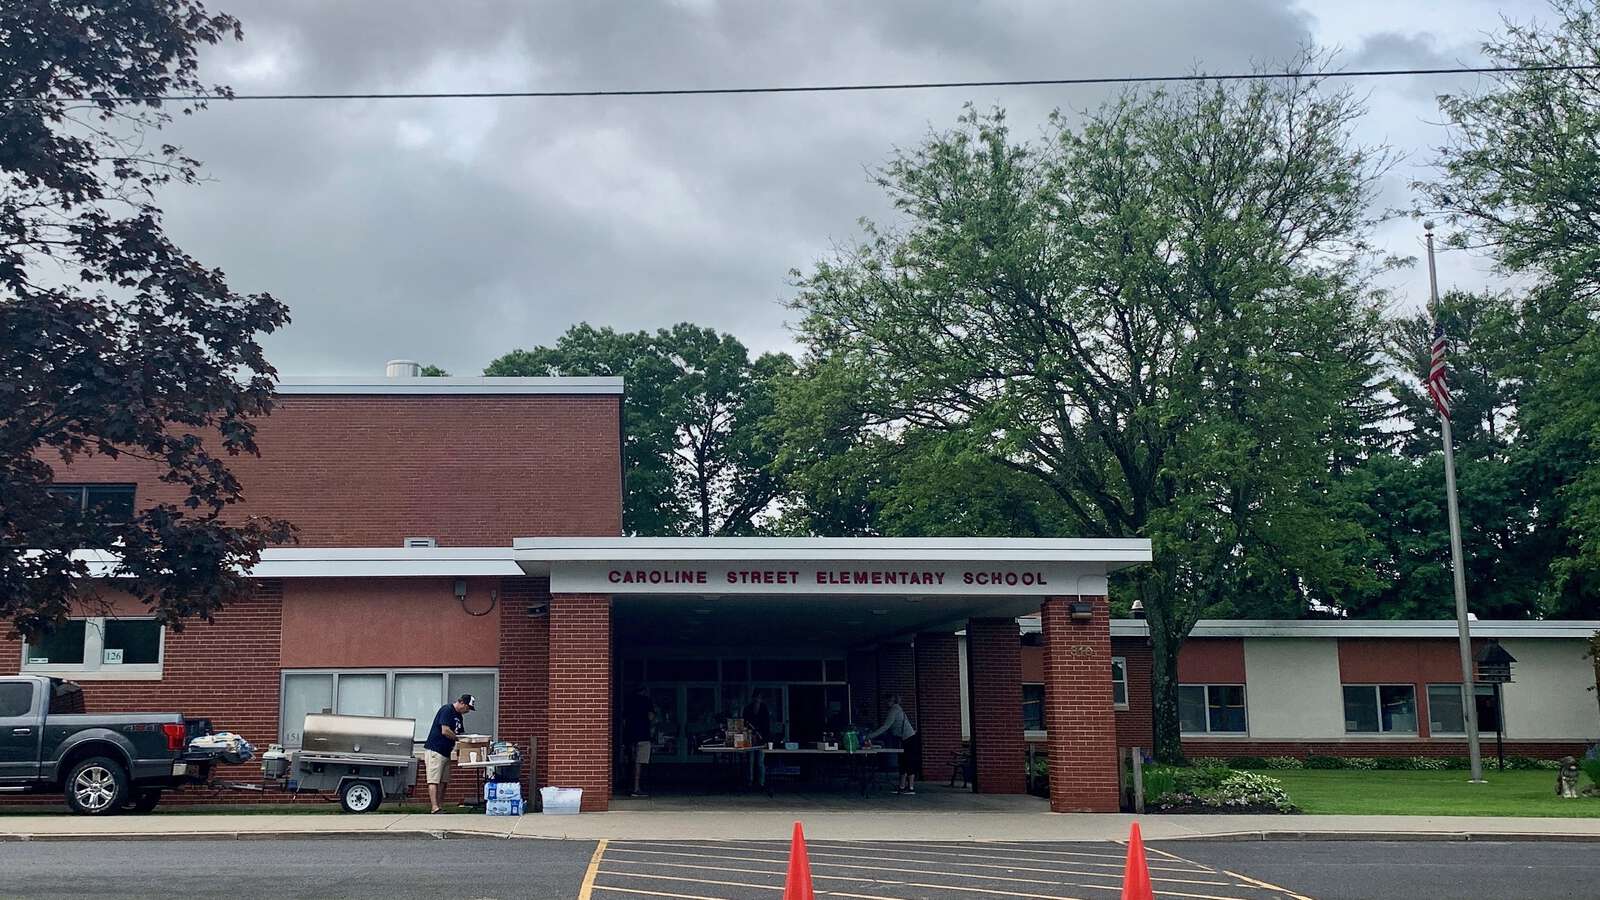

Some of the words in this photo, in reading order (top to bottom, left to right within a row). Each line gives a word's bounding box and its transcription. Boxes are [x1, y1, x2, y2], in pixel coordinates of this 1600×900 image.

[608, 570, 708, 584] CAROLINE
[727, 571, 799, 584] STREET
[816, 571, 945, 585] ELEMENTARY
[963, 571, 1047, 586] SCHOOL
[106, 652, 121, 661] 126
[286, 732, 300, 742] 151
